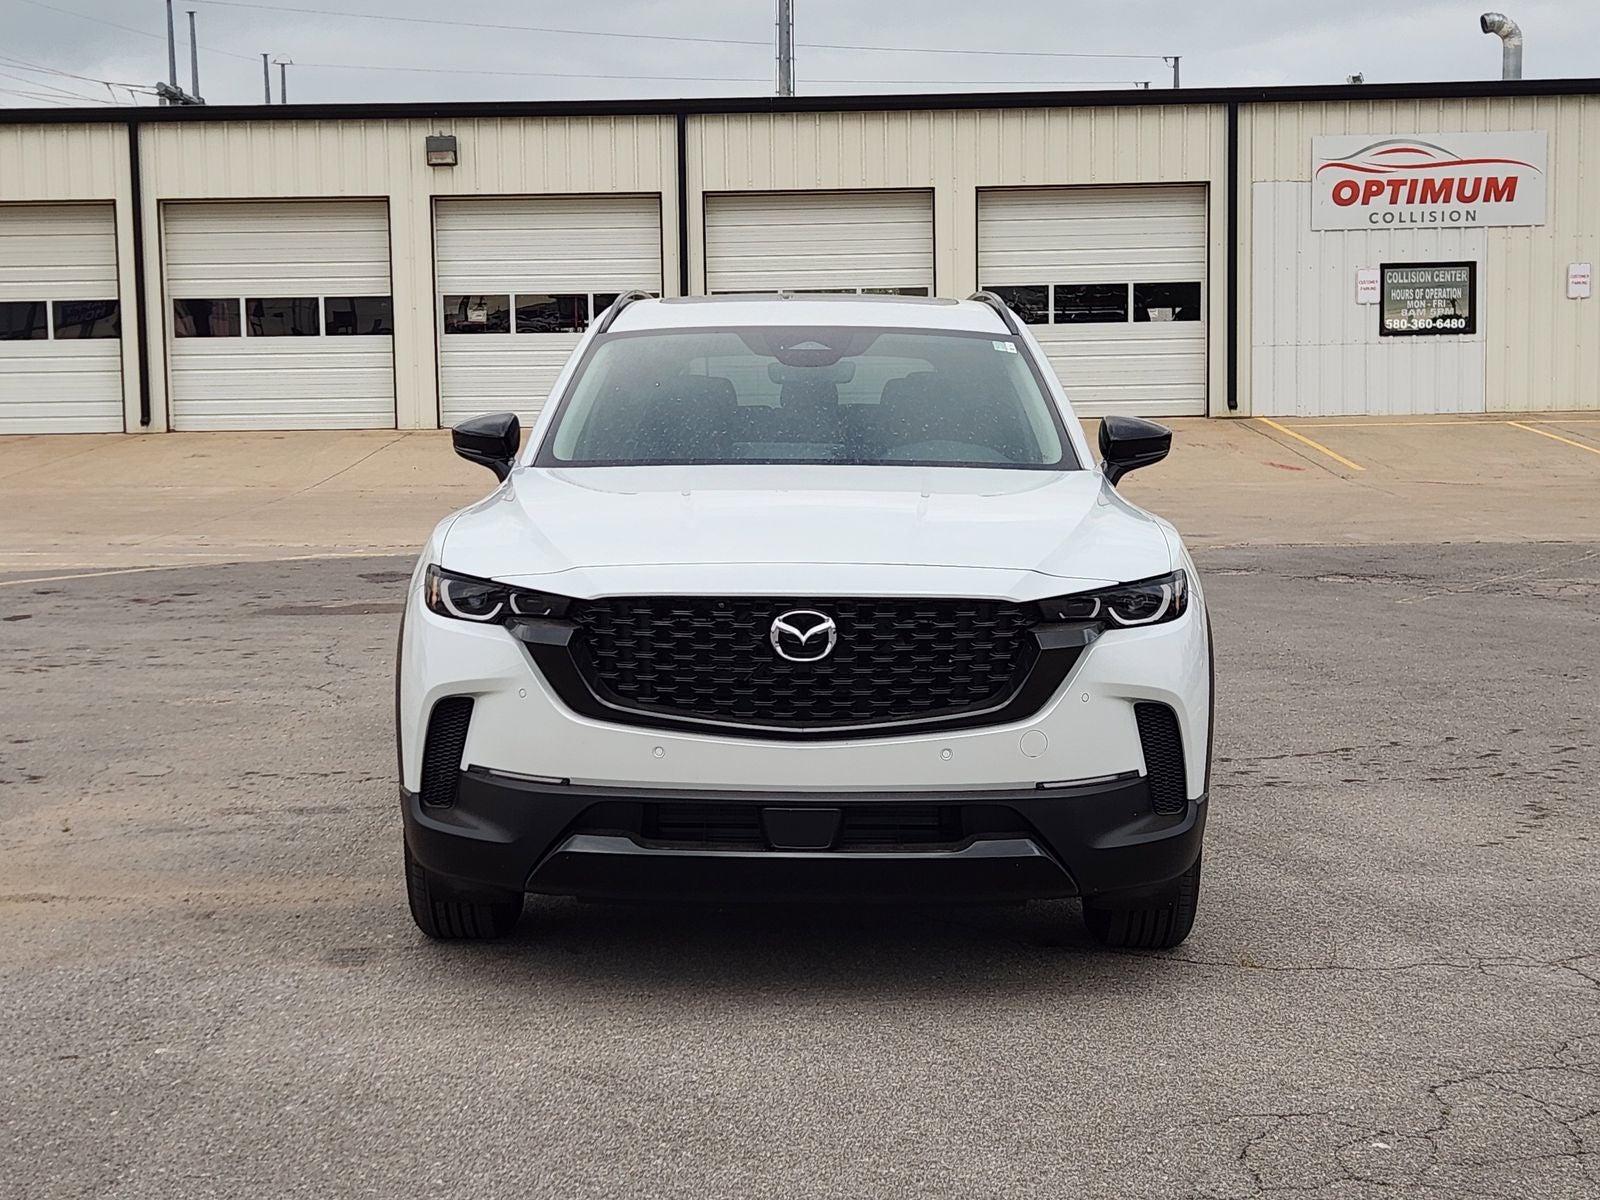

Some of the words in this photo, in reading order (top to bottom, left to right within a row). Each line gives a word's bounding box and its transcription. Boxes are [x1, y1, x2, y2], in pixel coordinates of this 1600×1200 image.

[1331, 176, 1519, 207] OPTIMUM
[1368, 210, 1477, 224] COLLISION
[1386, 270, 1432, 283] COLLISION
[1433, 270, 1468, 283] CENTER
[1391, 288, 1413, 300] HOURS
[1415, 288, 1424, 299] OF
[1425, 287, 1462, 299] OPERATION
[1406, 300, 1426, 308] MON
[1432, 299, 1446, 308] FRI
[1401, 308, 1426, 317] 8AM
[1429, 307, 1455, 317] 5PM
[1385, 318, 1466, 329] 580-360-6480
